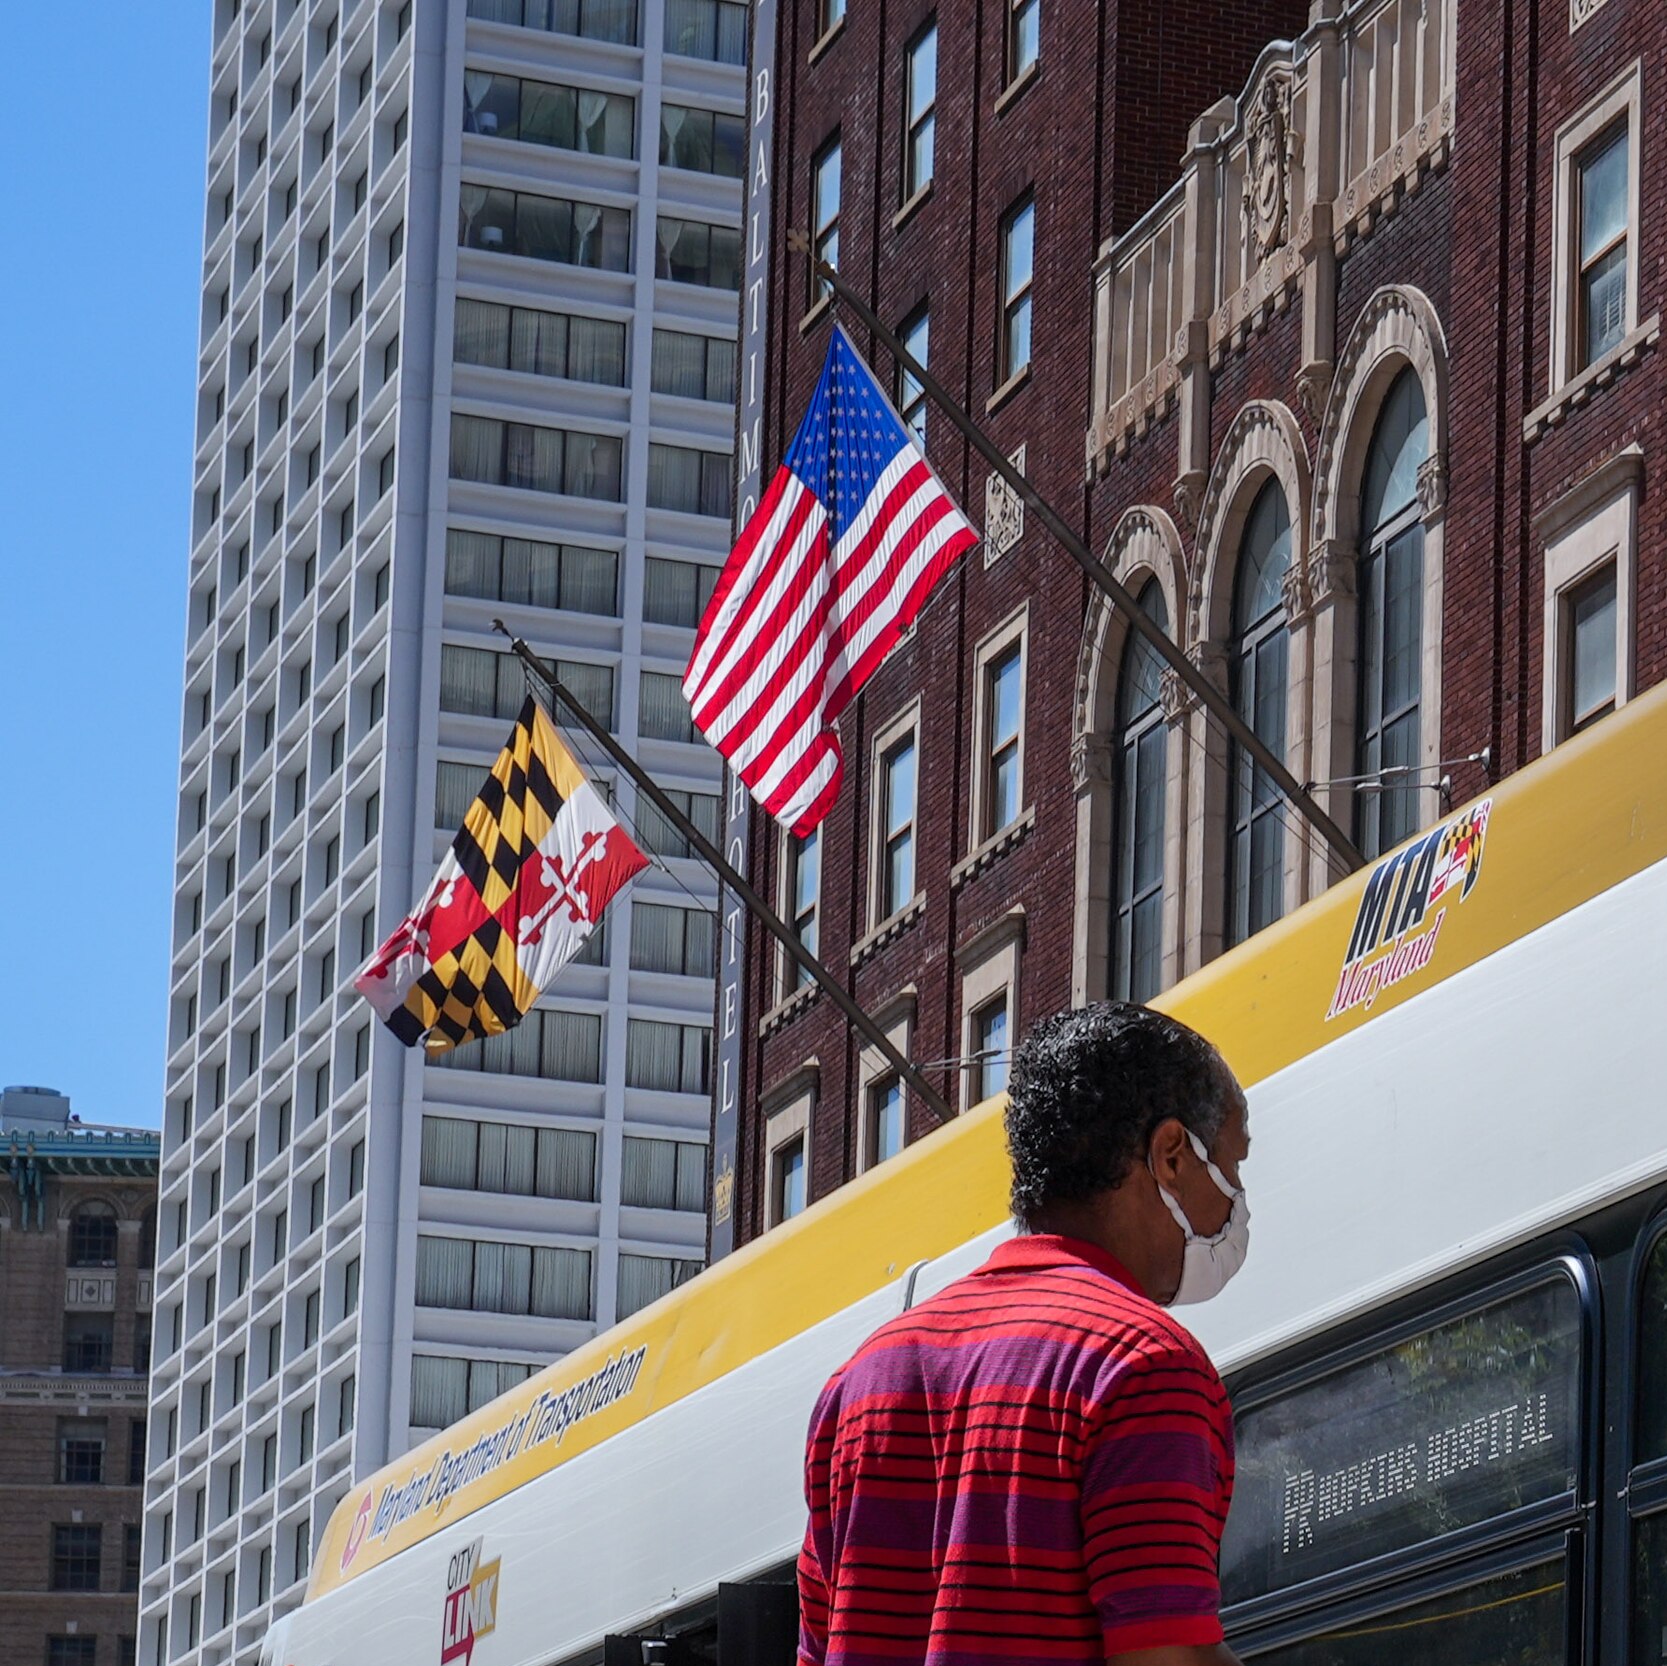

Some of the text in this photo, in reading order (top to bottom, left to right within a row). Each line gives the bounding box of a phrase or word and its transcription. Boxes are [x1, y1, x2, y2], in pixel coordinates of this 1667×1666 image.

[1344, 824, 1447, 963] MTA
[1324, 907, 1447, 1022] Maryland
[367, 1344, 648, 1544] Maryland Department of Transportation
[1318, 1442, 1418, 1522] HOPKINS
[1427, 1393, 1554, 1483] HOSPITAL
[442, 1572, 498, 1652] LINK
[447, 1543, 476, 1591] CITY
